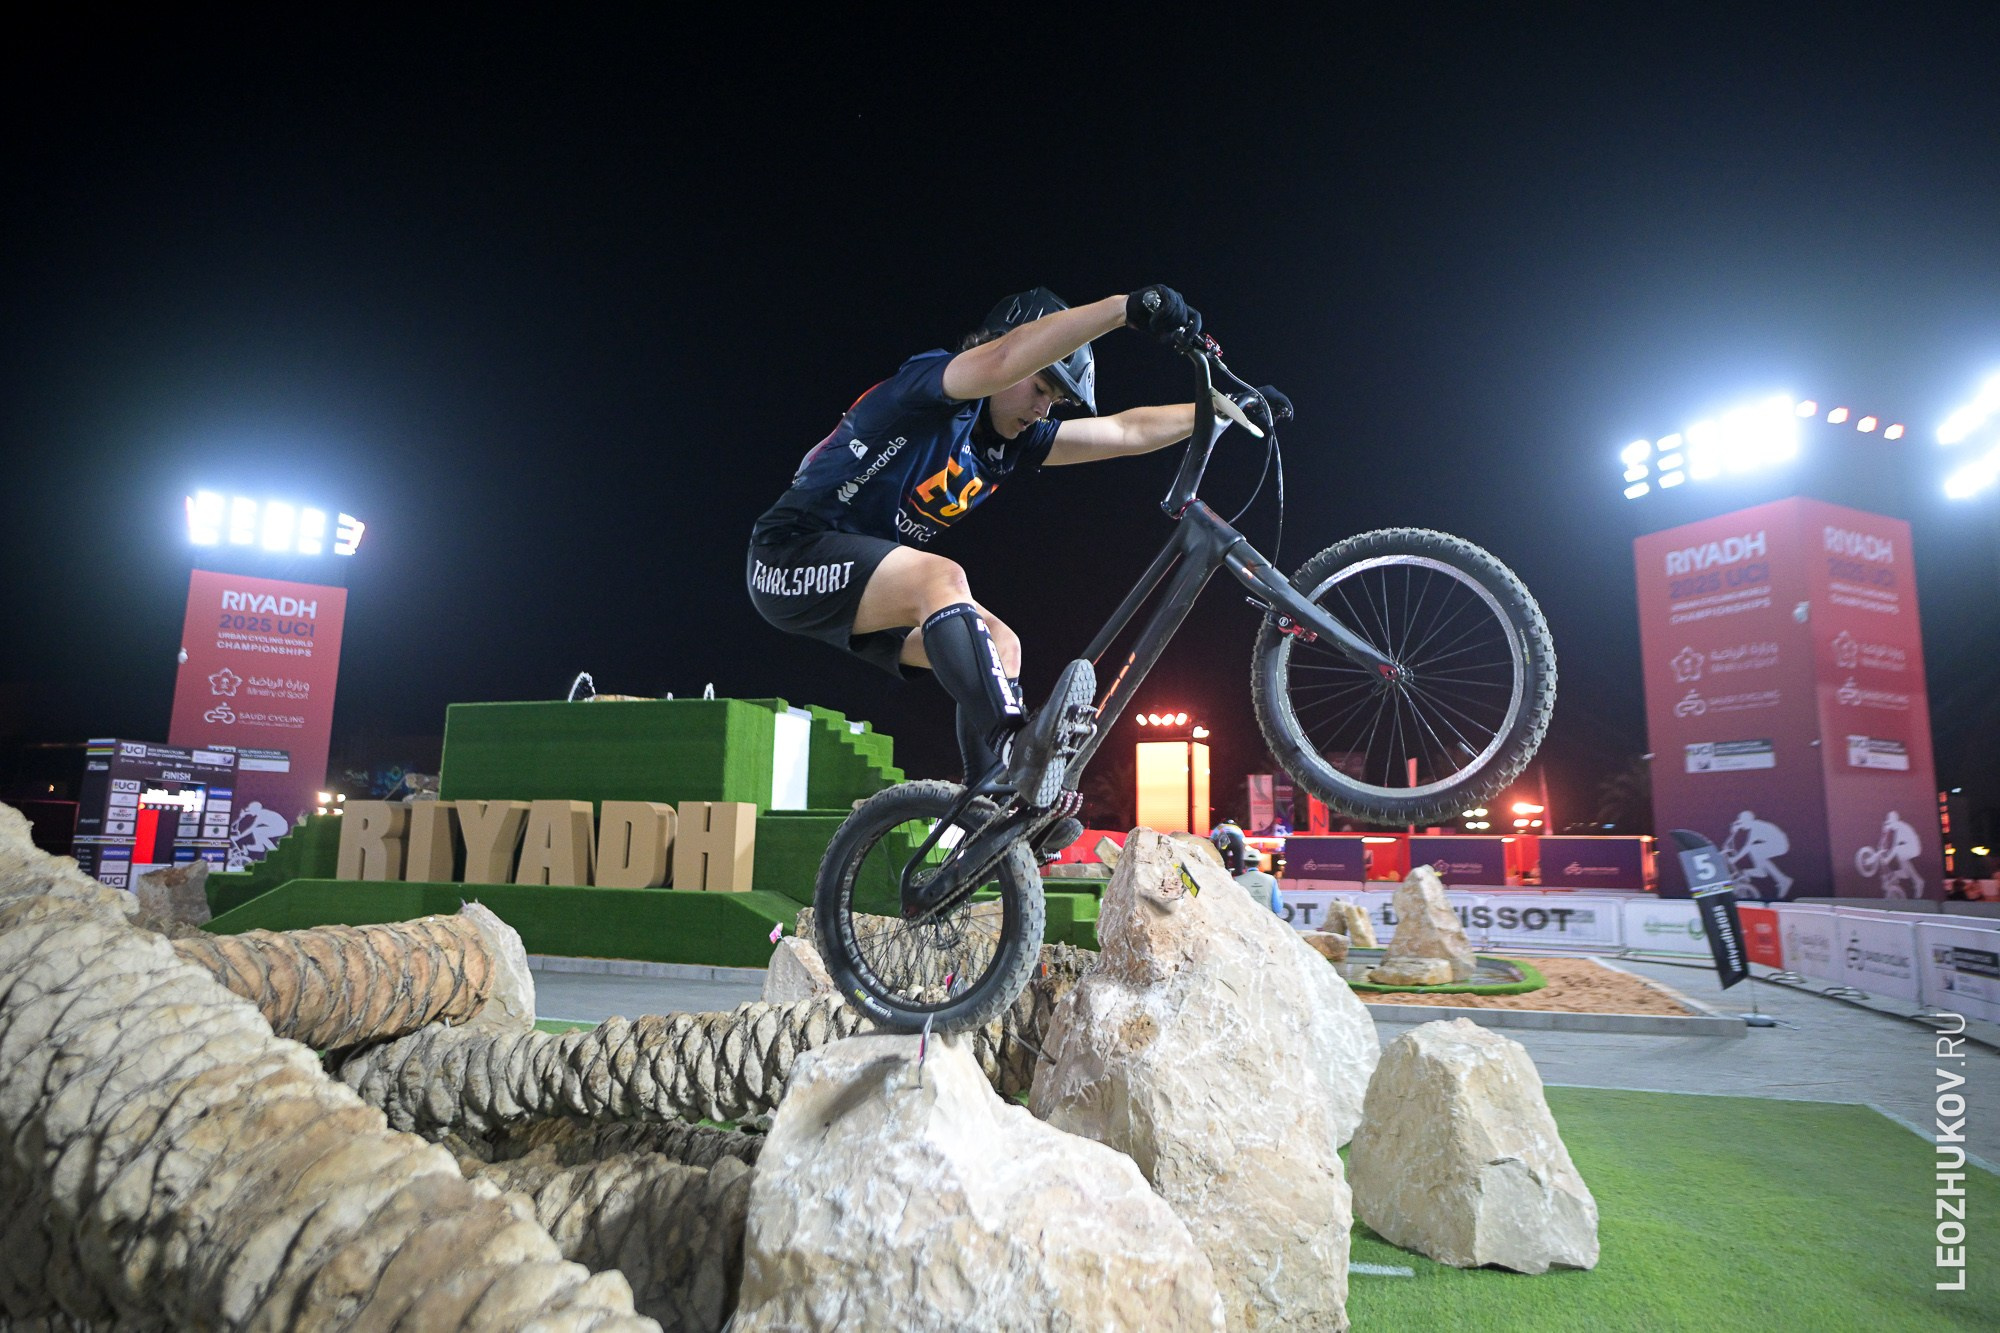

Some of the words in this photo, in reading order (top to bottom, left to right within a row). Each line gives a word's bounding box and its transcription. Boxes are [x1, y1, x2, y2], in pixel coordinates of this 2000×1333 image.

[1666, 530, 1767, 576] RIYADH
[1824, 525, 1895, 563] RIYADH
[222, 590, 317, 619] RIYADH
[219, 614, 272, 632] 2025
[277, 620, 315, 637] UCI
[216, 640, 312, 657] CHAMPIONSHIPS
[218, 632, 248, 641] URBAN
[248, 634, 284, 645] CYCLING
[284, 637, 314, 648] WORLD
[240, 712, 266, 721] SAUDI
[268, 714, 305, 724] CYCLING
[125, 745, 144, 755] UCI
[162, 771, 191, 781] FINISH
[118, 782, 137, 791] UCI
[337, 800, 757, 892] RIYADH
[1693, 853, 1716, 880] 5
[104, 876, 124, 886] UCI
[1453, 905, 1575, 932] ISSOT
